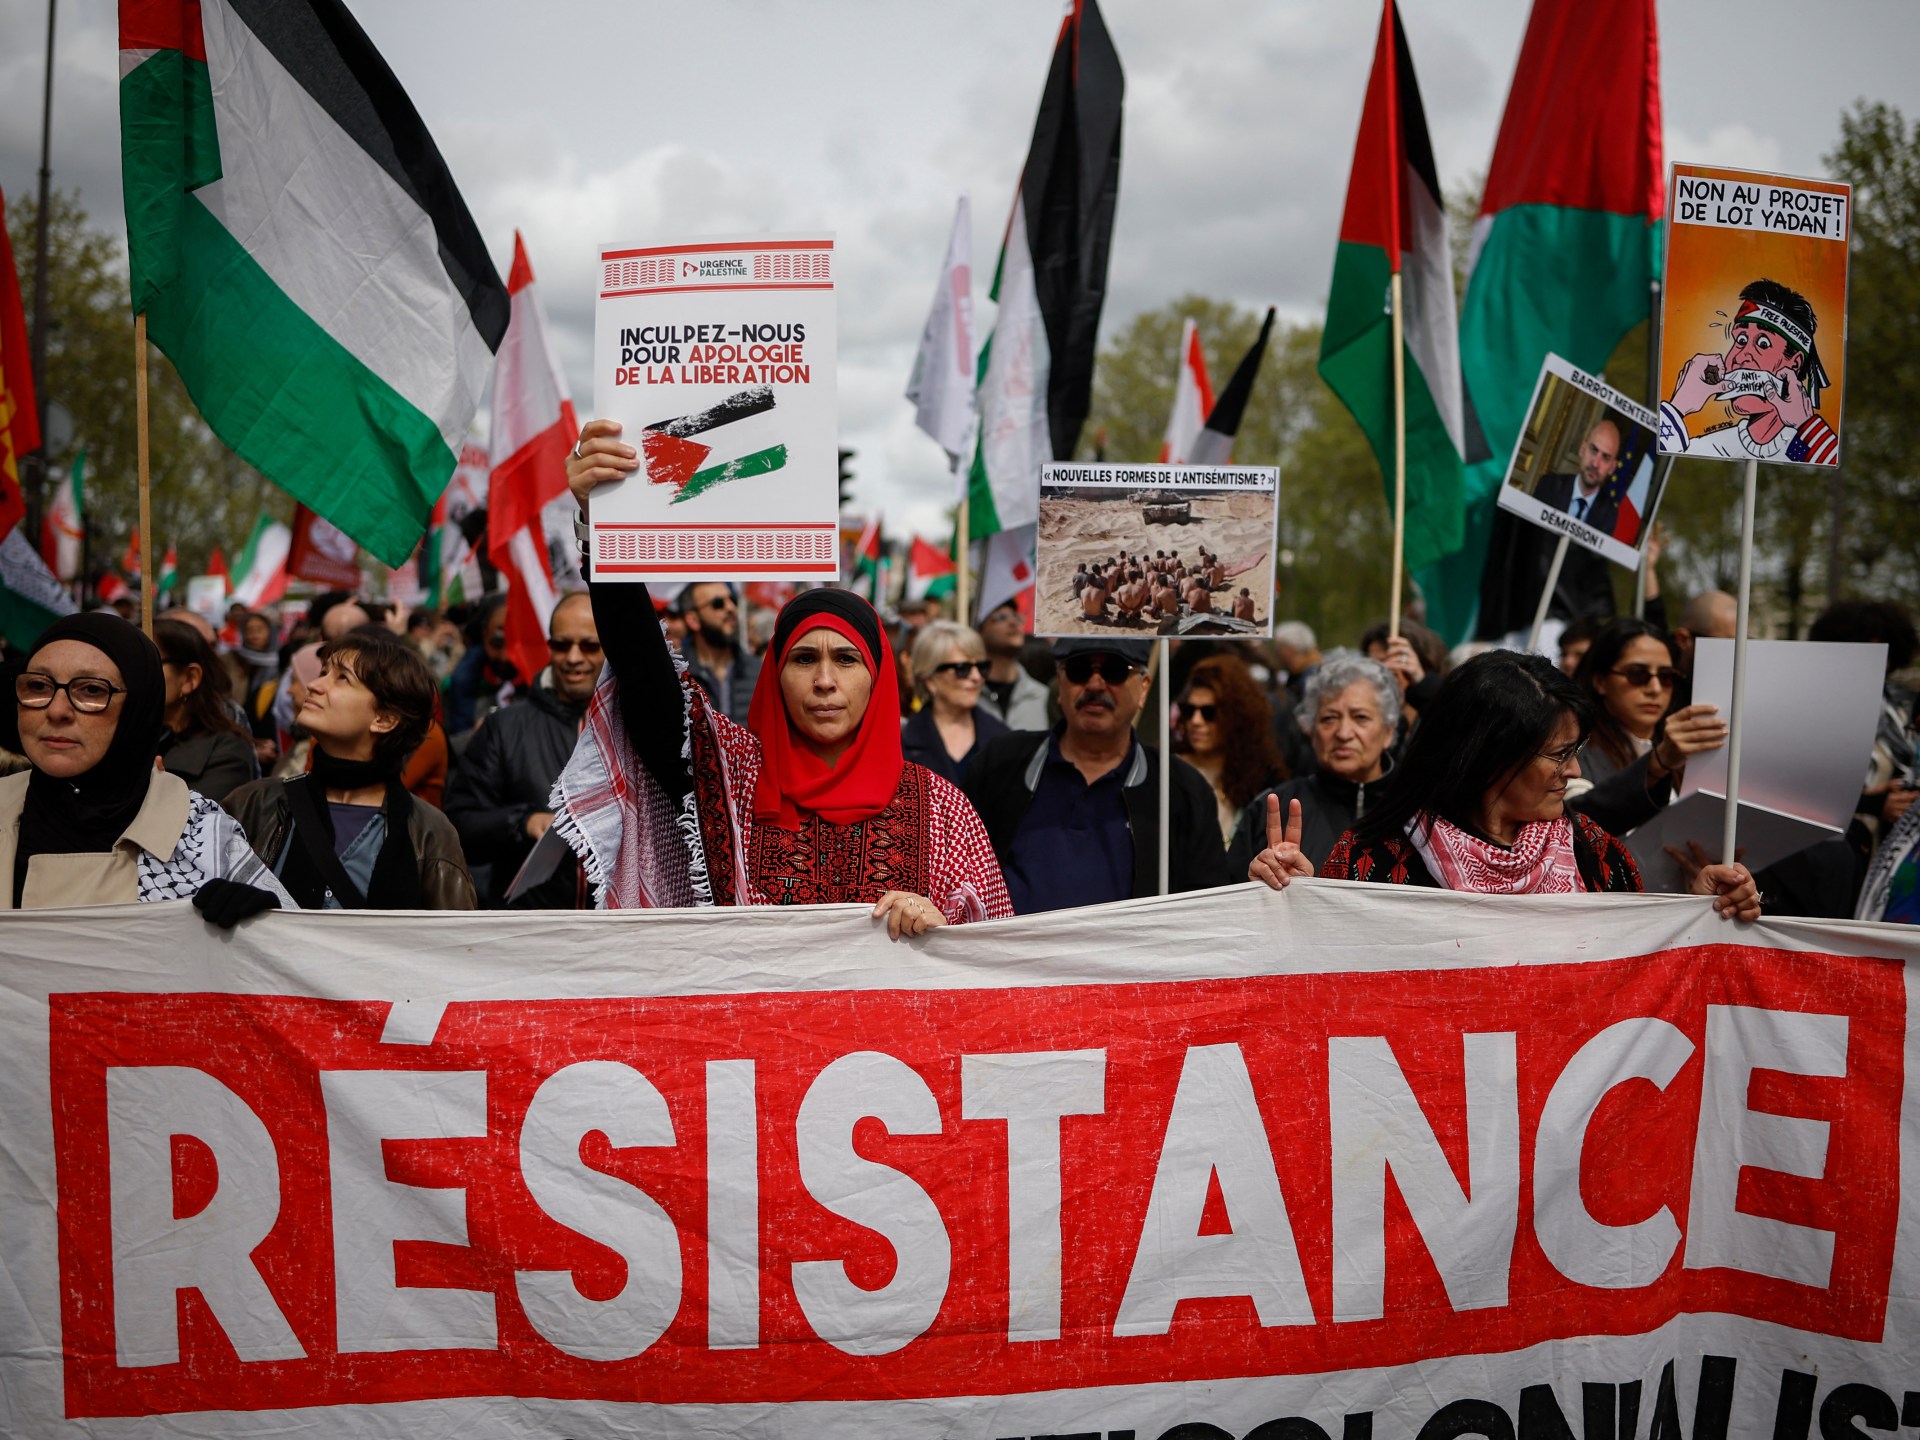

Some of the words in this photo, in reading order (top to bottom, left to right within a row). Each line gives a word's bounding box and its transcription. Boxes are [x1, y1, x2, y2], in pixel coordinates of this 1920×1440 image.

[1679, 179, 1725, 202] NON
[1732, 185, 1760, 205] AU
[1769, 189, 1845, 216] PROJET
[1680, 202, 1707, 221] DE
[1716, 205, 1753, 225] LOI
[1761, 209, 1827, 235] YADAN
[1835, 218, 1841, 237] !
[700, 259, 743, 268] URGENCE
[700, 267, 748, 277] PALESTINE
[620, 323, 806, 347] INCULPEZ-NOUS
[1760, 308, 1780, 323] FREE
[1780, 318, 1810, 347] PALESTINE
[621, 346, 681, 366] POUR
[688, 344, 803, 364] APOLOGIE
[615, 366, 640, 386] DE
[647, 366, 675, 385] LA
[681, 361, 810, 384] LIBÉRATION
[1571, 370, 1613, 401] BARROT
[1741, 371, 1761, 381] ANTI-
[1052, 469, 1112, 482] NOUVELLES
[1115, 470, 1156, 483] FORMES
[1158, 471, 1171, 483] DE
[1174, 469, 1258, 485] L'ANTISÉMITISME
[1540, 509, 1600, 546] DÉMISSION
[106, 1001, 1850, 1368] RÉSISTANCE
